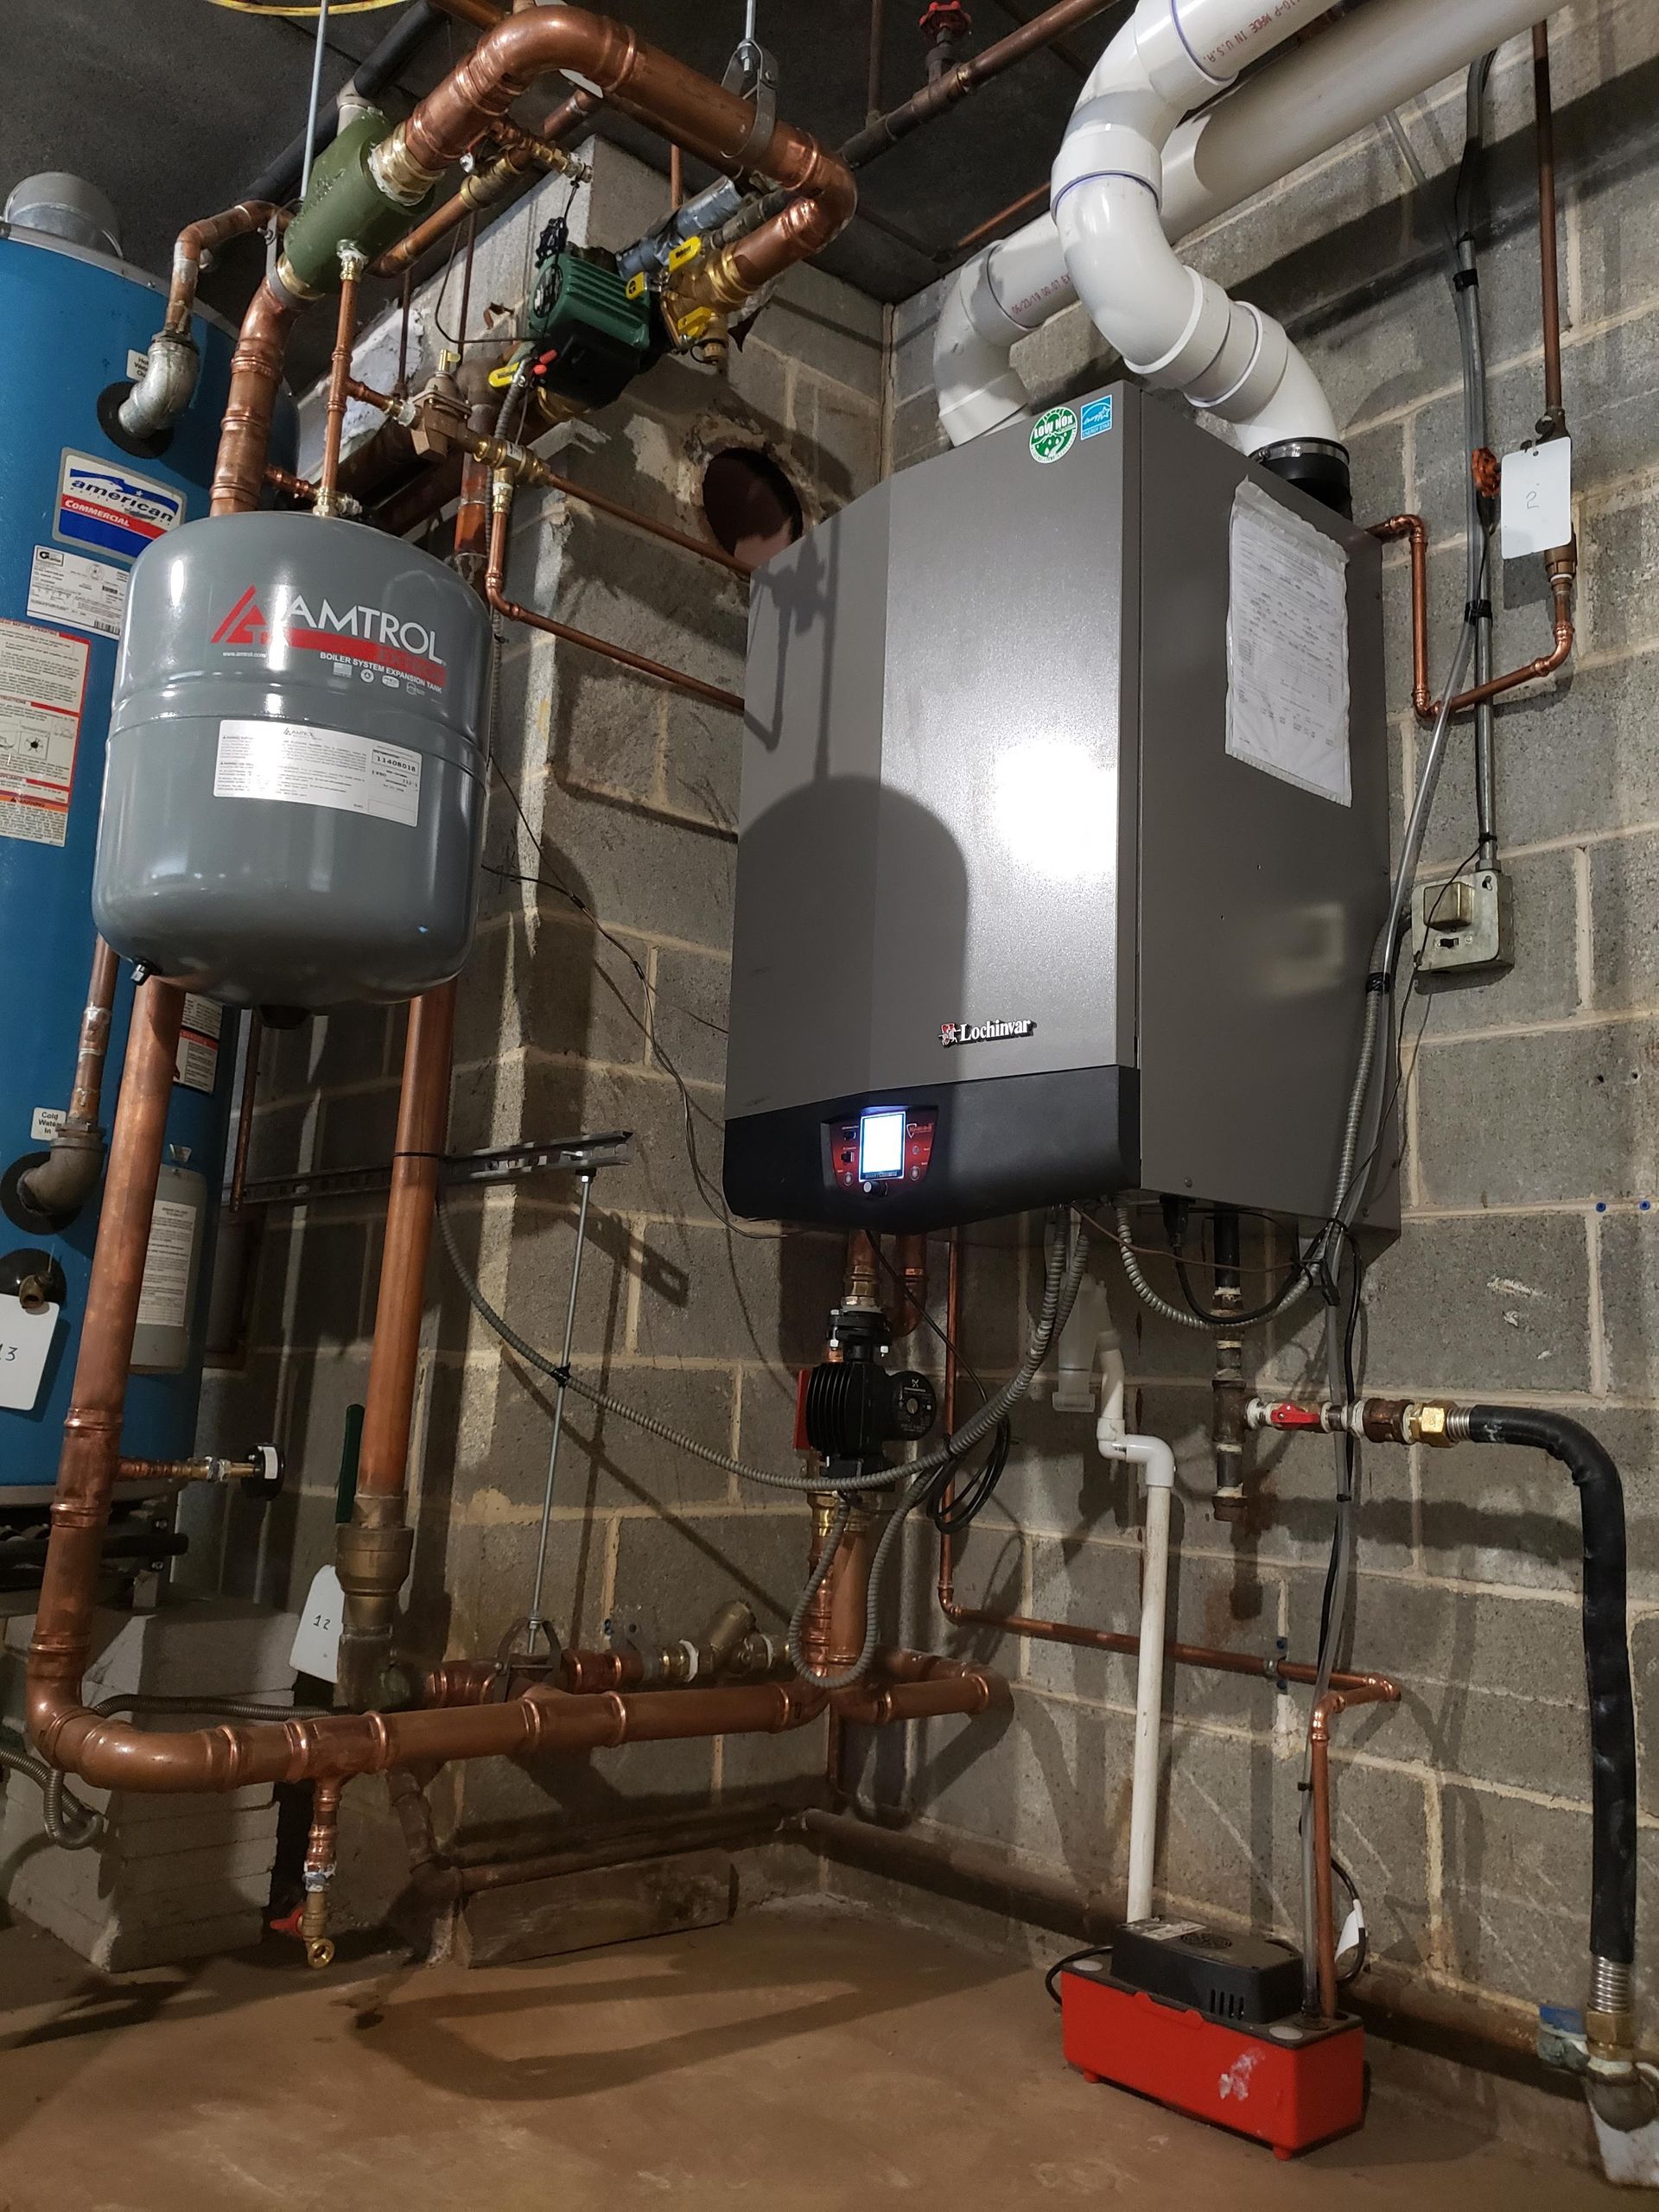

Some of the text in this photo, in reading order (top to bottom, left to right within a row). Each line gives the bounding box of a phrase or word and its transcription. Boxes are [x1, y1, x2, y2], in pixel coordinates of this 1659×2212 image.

[1203, 0, 1300, 63] 10-P MADE IN U.S.A.
[1033, 421, 1054, 439] LOW
[65, 499, 130, 527] COMMERCIAL
[71, 479, 173, 523] american
[1525, 491, 1540, 510] 2
[286, 594, 444, 664] AMTROL
[320, 652, 352, 664] BOILER
[353, 658, 385, 673] SYSTEM
[385, 667, 428, 687] EXPANSION
[426, 681, 443, 694] TANK
[960, 1020, 1032, 1042] Lochinvar
[41, 1111, 59, 1121] Cold
[313, 1615, 331, 1630] 12
